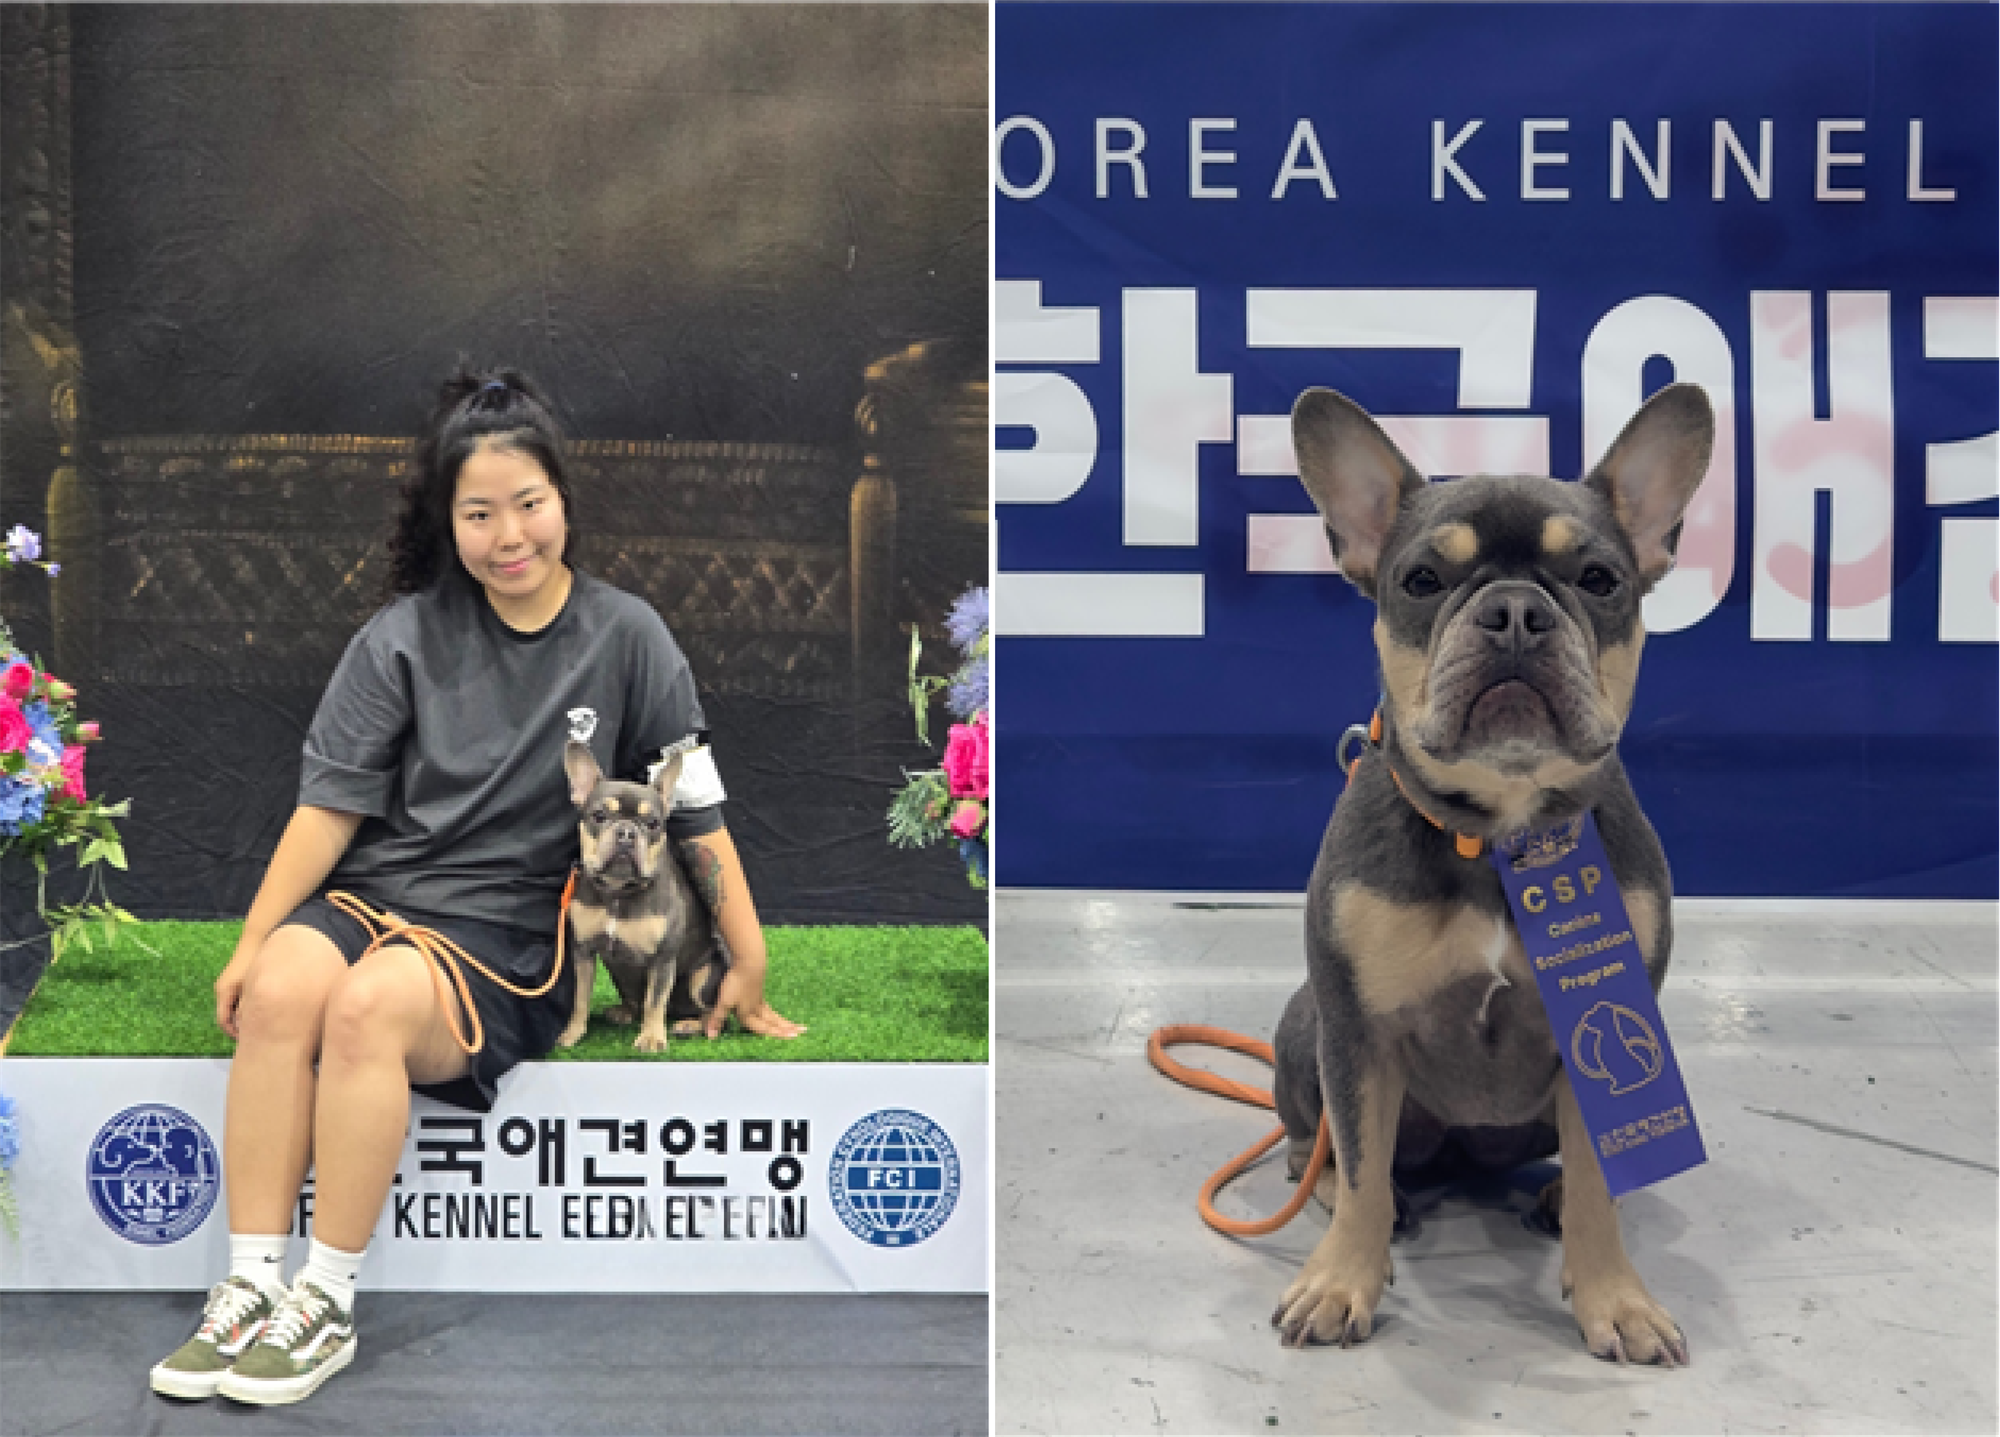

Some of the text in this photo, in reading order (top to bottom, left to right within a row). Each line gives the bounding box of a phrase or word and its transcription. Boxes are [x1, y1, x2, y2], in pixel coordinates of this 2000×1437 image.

[1431, 117, 1956, 201] KENNEL
[392, 1115, 810, 1192] 국애견연맹
[867, 1168, 917, 1188] FCI
[394, 1193, 543, 1239] KENNEL
